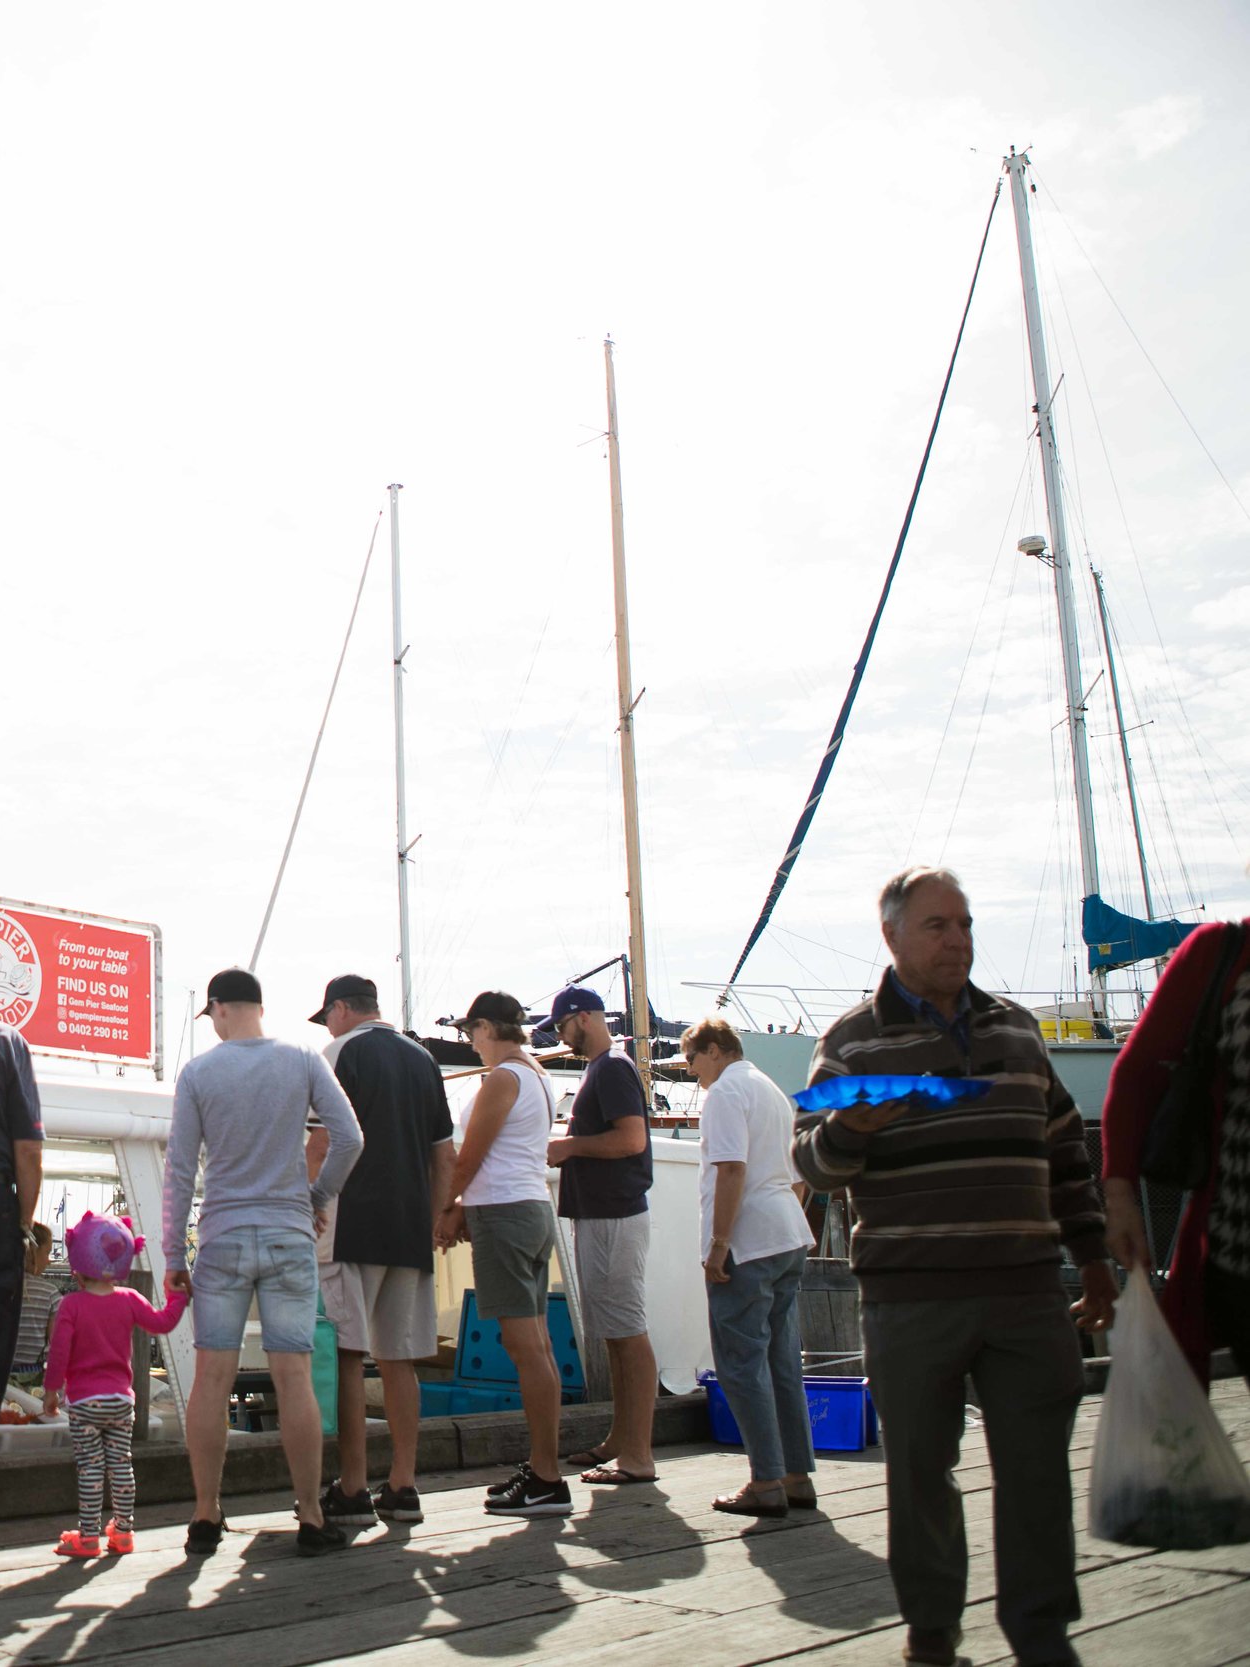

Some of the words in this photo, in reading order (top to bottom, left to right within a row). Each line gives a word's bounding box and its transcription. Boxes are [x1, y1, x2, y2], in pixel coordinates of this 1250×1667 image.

[58, 938, 85, 953] From
[87, 946, 105, 957] our
[106, 947, 129, 961] boat
[58, 953, 70, 966] to
[72, 957, 99, 970] your
[101, 960, 128, 975] table
[57, 976, 87, 993] FIND
[90, 980, 107, 996] US
[110, 984, 129, 999] ON
[68, 997, 85, 1007] Gem
[86, 999, 100, 1009] Pier
[101, 1001, 129, 1013] Seafood
[68, 1022, 92, 1036] 0402
[93, 1026, 111, 1039] 290
[111, 1029, 129, 1040] 812
